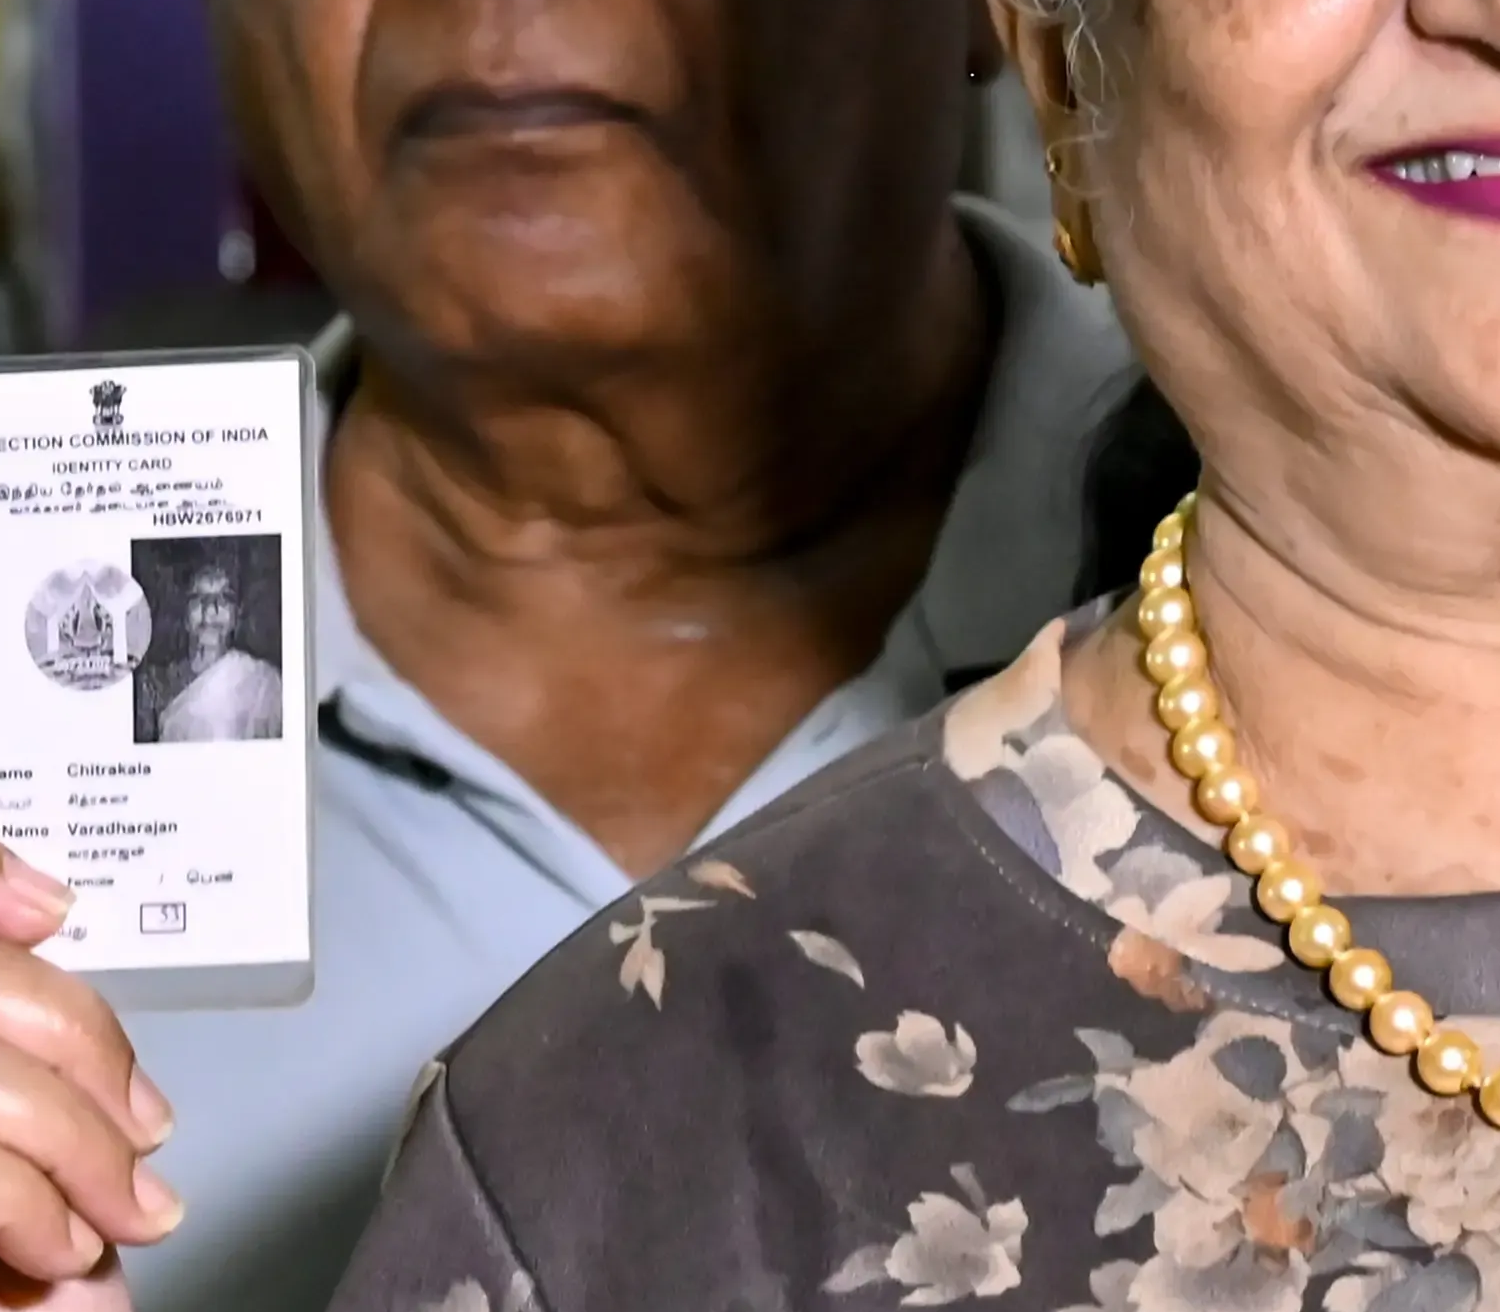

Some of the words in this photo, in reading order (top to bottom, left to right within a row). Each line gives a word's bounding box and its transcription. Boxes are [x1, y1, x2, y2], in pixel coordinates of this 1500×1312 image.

[69, 431, 186, 447] COMMISSION
[191, 429, 215, 443] OF
[221, 427, 269, 442] INDIA
[52, 459, 122, 474] IDENTITY
[128, 457, 173, 472] CARD
[66, 762, 152, 778] Chitrakala
[1, 824, 50, 838] Name
[67, 820, 178, 836] Varadharajan
